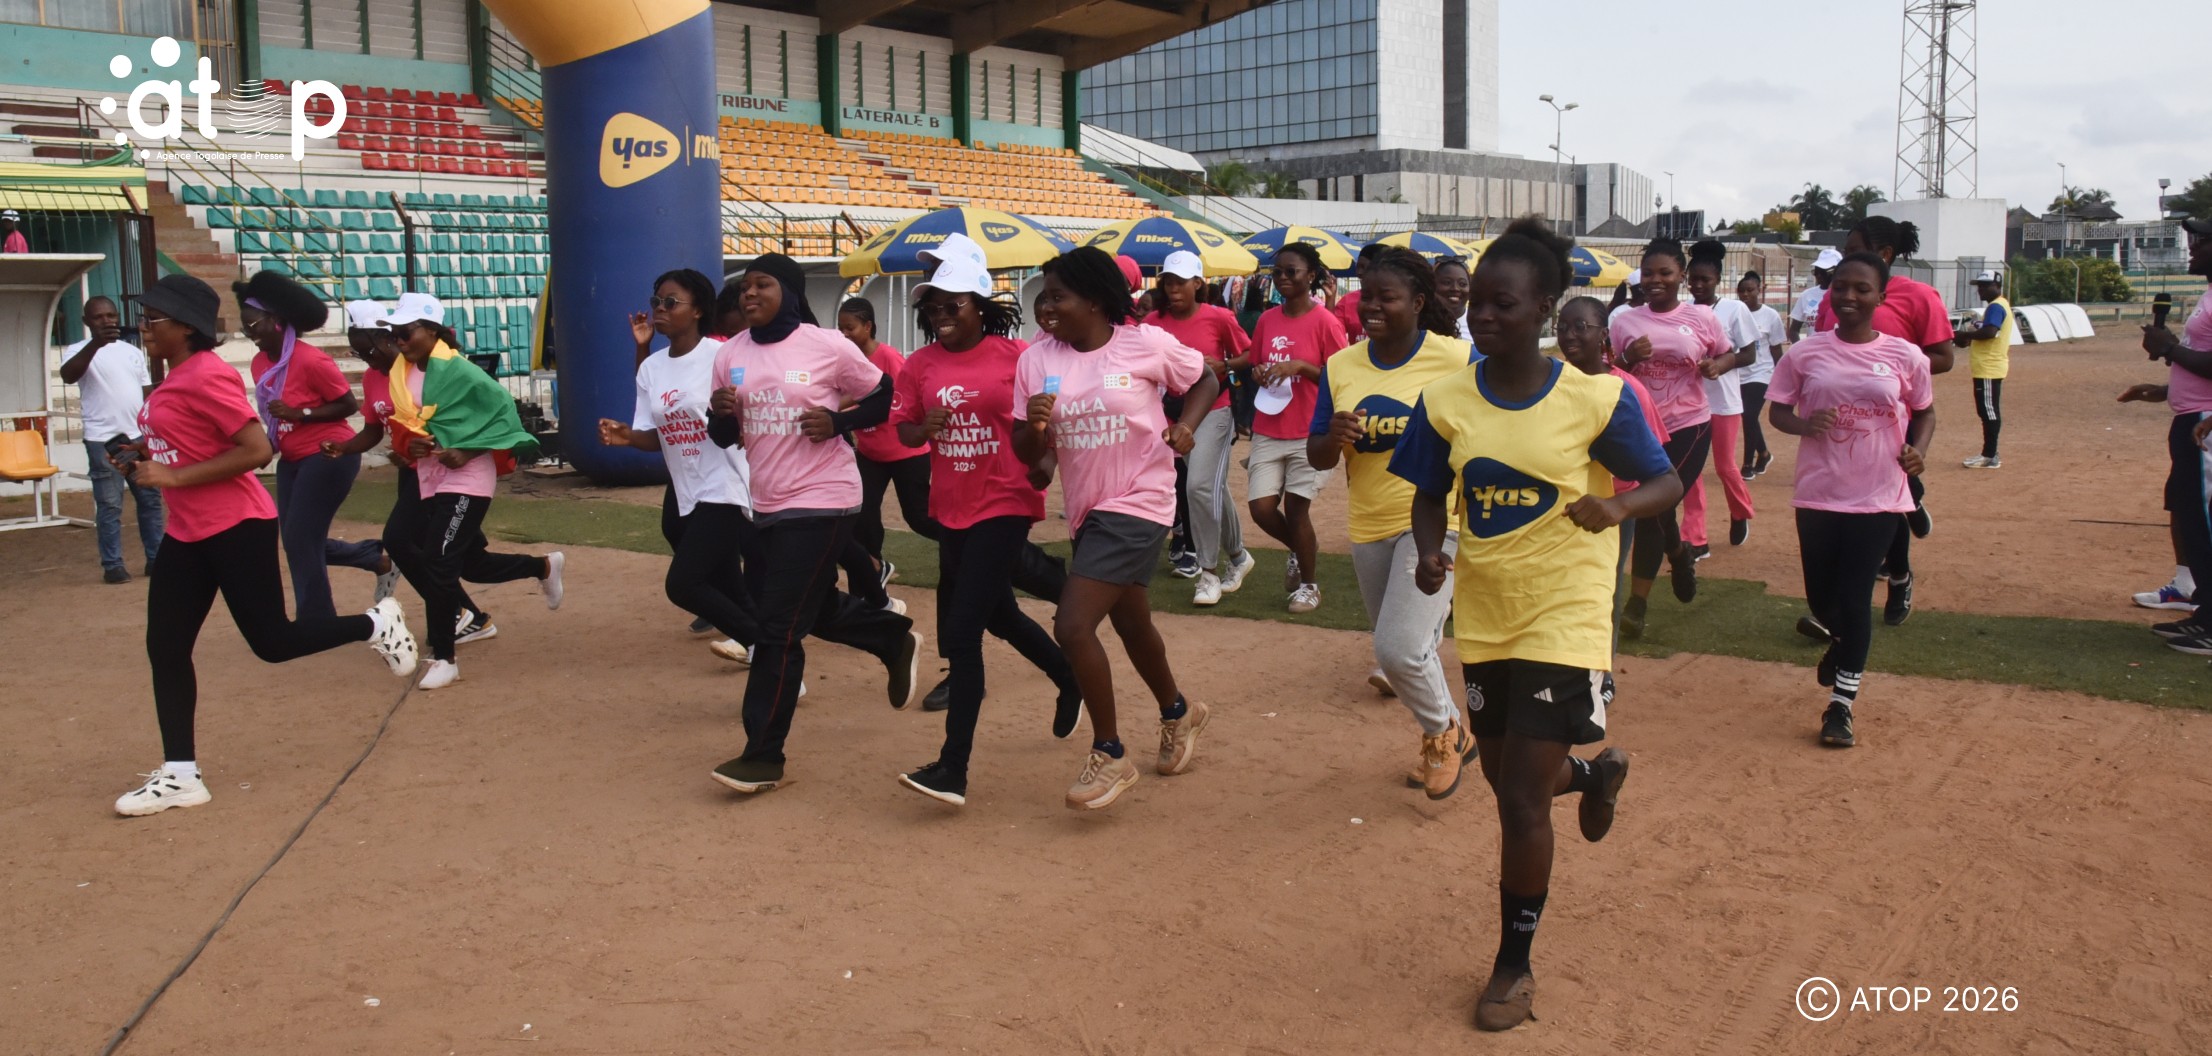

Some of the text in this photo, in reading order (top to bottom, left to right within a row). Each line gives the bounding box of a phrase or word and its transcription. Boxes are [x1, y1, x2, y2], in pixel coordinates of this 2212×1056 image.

[843, 107, 923, 126] LATERALE
[930, 117, 940, 128] B
[613, 137, 668, 169] yas
[1268, 352, 1291, 362] MLA
[748, 389, 786, 404] MLA
[1060, 397, 1107, 418] MLA
[664, 410, 691, 422] MLA
[946, 412, 981, 427] MLA
[658, 419, 705, 436] HEALTH
[935, 426, 993, 442] HEALTH
[938, 441, 1001, 458] SUMMIT
[953, 461, 976, 472] 2026
[1472, 485, 1540, 519] yas
